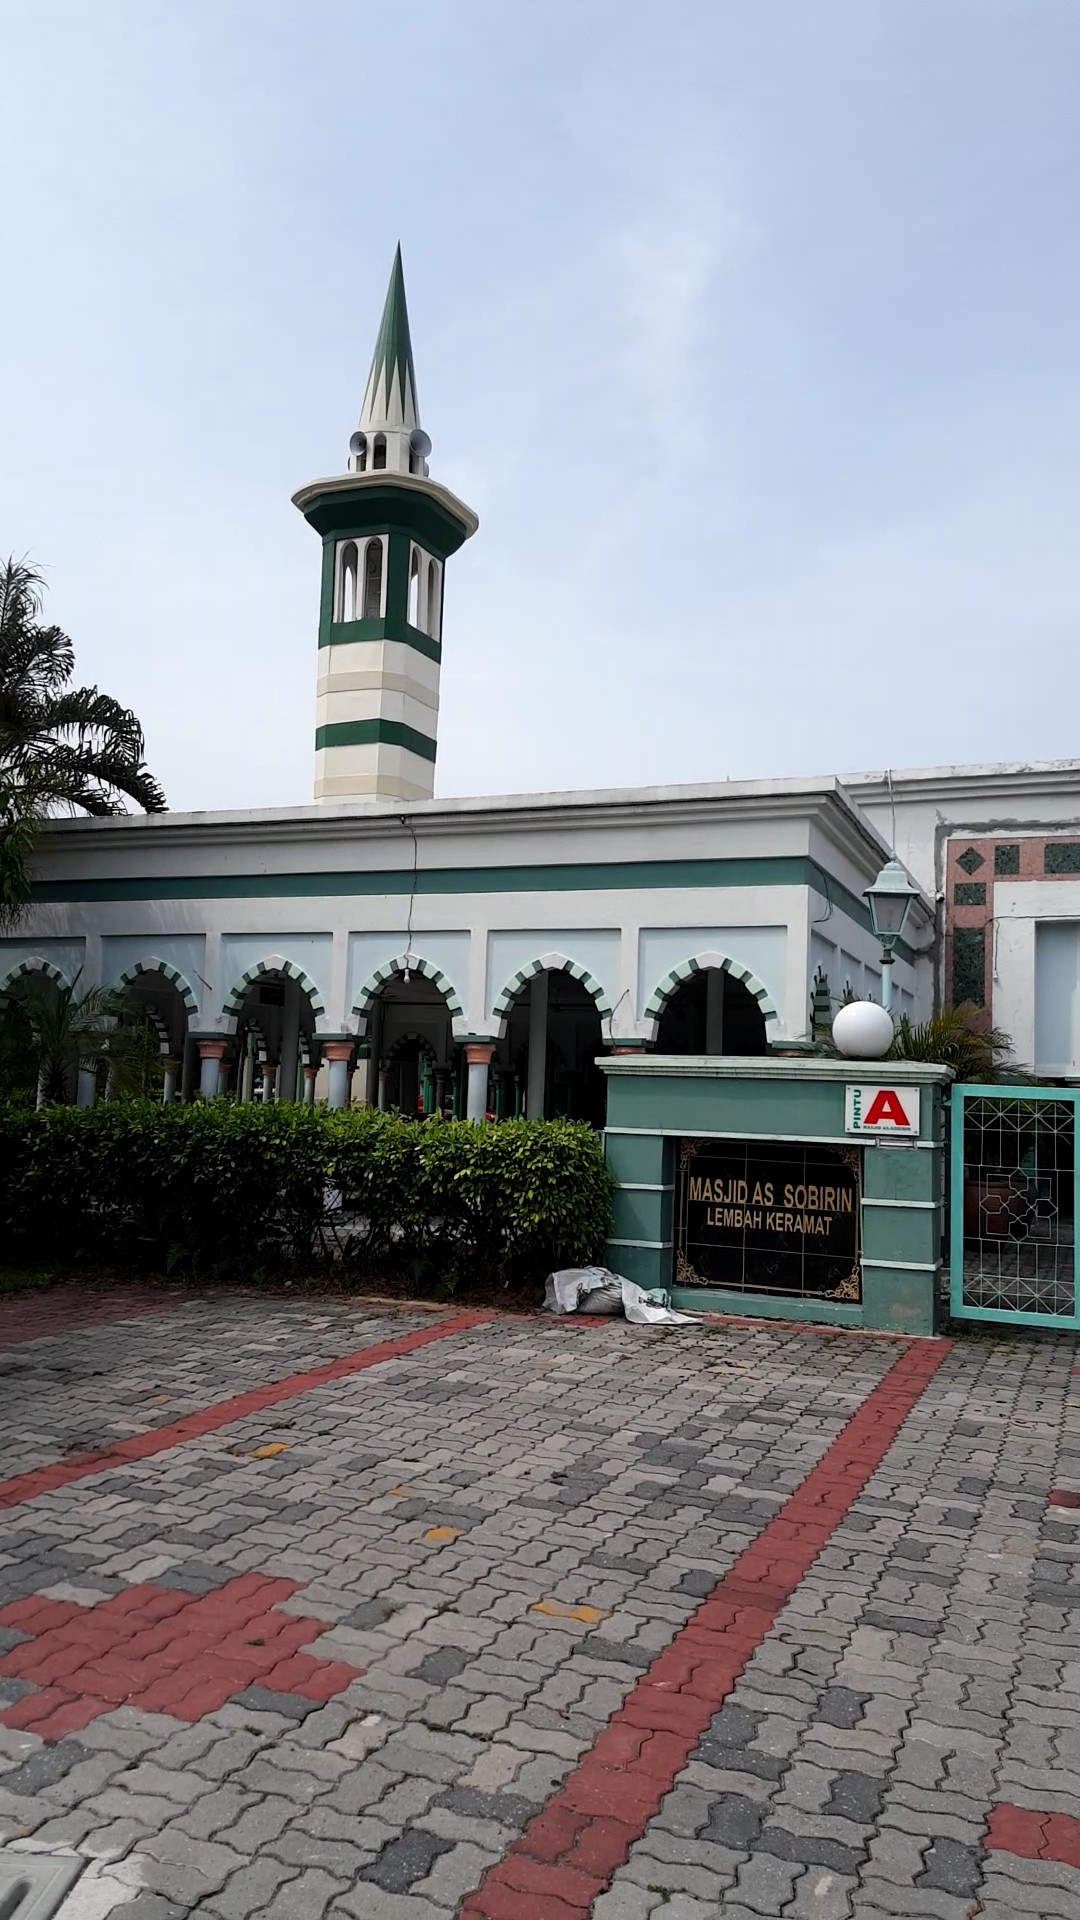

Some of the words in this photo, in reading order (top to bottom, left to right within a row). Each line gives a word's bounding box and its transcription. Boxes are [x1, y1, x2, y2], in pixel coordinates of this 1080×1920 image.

[853, 1089, 862, 1129] PINTU
[863, 1090, 910, 1126] A
[689, 1176, 748, 1204] MASJID
[752, 1181, 774, 1206] AS
[784, 1184, 852, 1212] SOBIRIN
[707, 1207, 762, 1230] LEMBAH
[766, 1211, 832, 1236] KERAMAT
